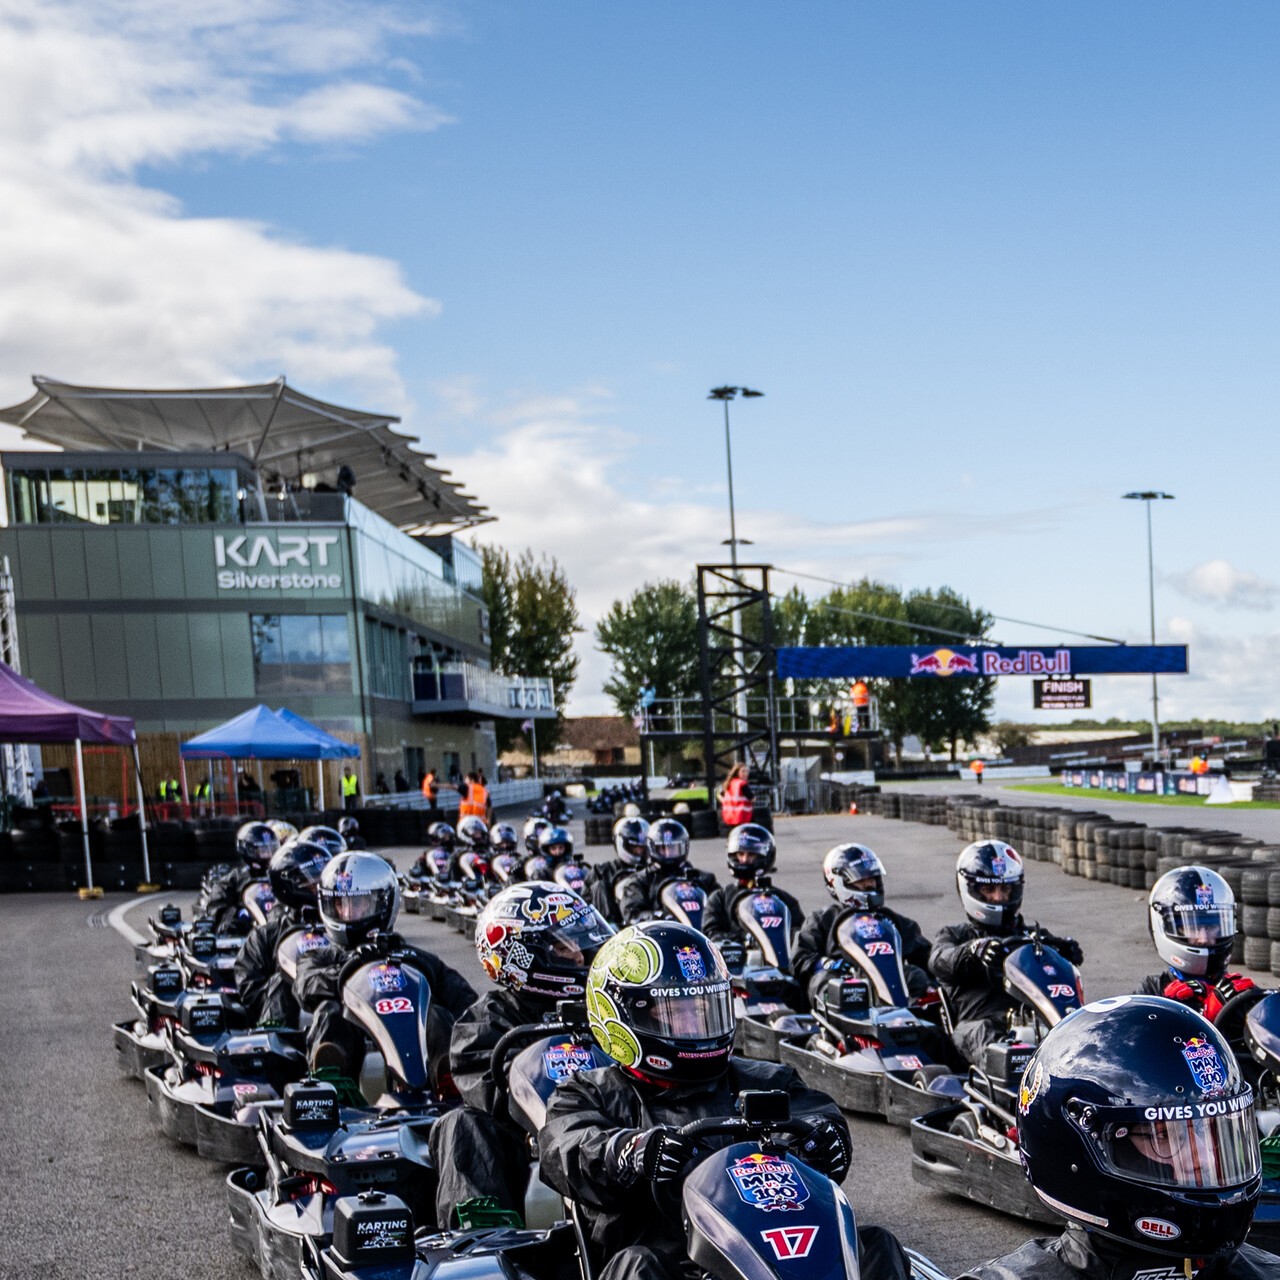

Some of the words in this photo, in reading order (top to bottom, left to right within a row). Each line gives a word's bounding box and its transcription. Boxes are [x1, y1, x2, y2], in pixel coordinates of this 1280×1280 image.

[215, 535, 337, 567] KART
[217, 570, 341, 589] Silverstone
[983, 652, 1028, 674] Red
[1029, 650, 1071, 674] Bull
[1042, 681, 1083, 693] FINISH
[549, 895, 569, 903] BELL
[560, 912, 580, 927] GIVES
[760, 916, 783, 929] 77
[864, 942, 894, 957] 72
[650, 987, 681, 997] GIVES
[683, 986, 704, 996] YOU
[1048, 984, 1075, 998] 73
[375, 996, 415, 1015] 82
[550, 1058, 589, 1069] MAX
[649, 1057, 669, 1068] BELL
[1191, 1056, 1221, 1073] MAX
[1200, 1071, 1223, 1087] 100
[296, 1099, 333, 1107] KARTING
[1144, 1105, 1193, 1120] GIVES
[1196, 1100, 1227, 1117] YOU
[733, 1164, 764, 1177] Red
[763, 1163, 794, 1174] Bull
[740, 1172, 798, 1190] MAX
[752, 1186, 798, 1201] 100
[357, 1219, 408, 1232] KARTING
[1141, 1220, 1175, 1236] BELL
[760, 1225, 820, 1261] 17
